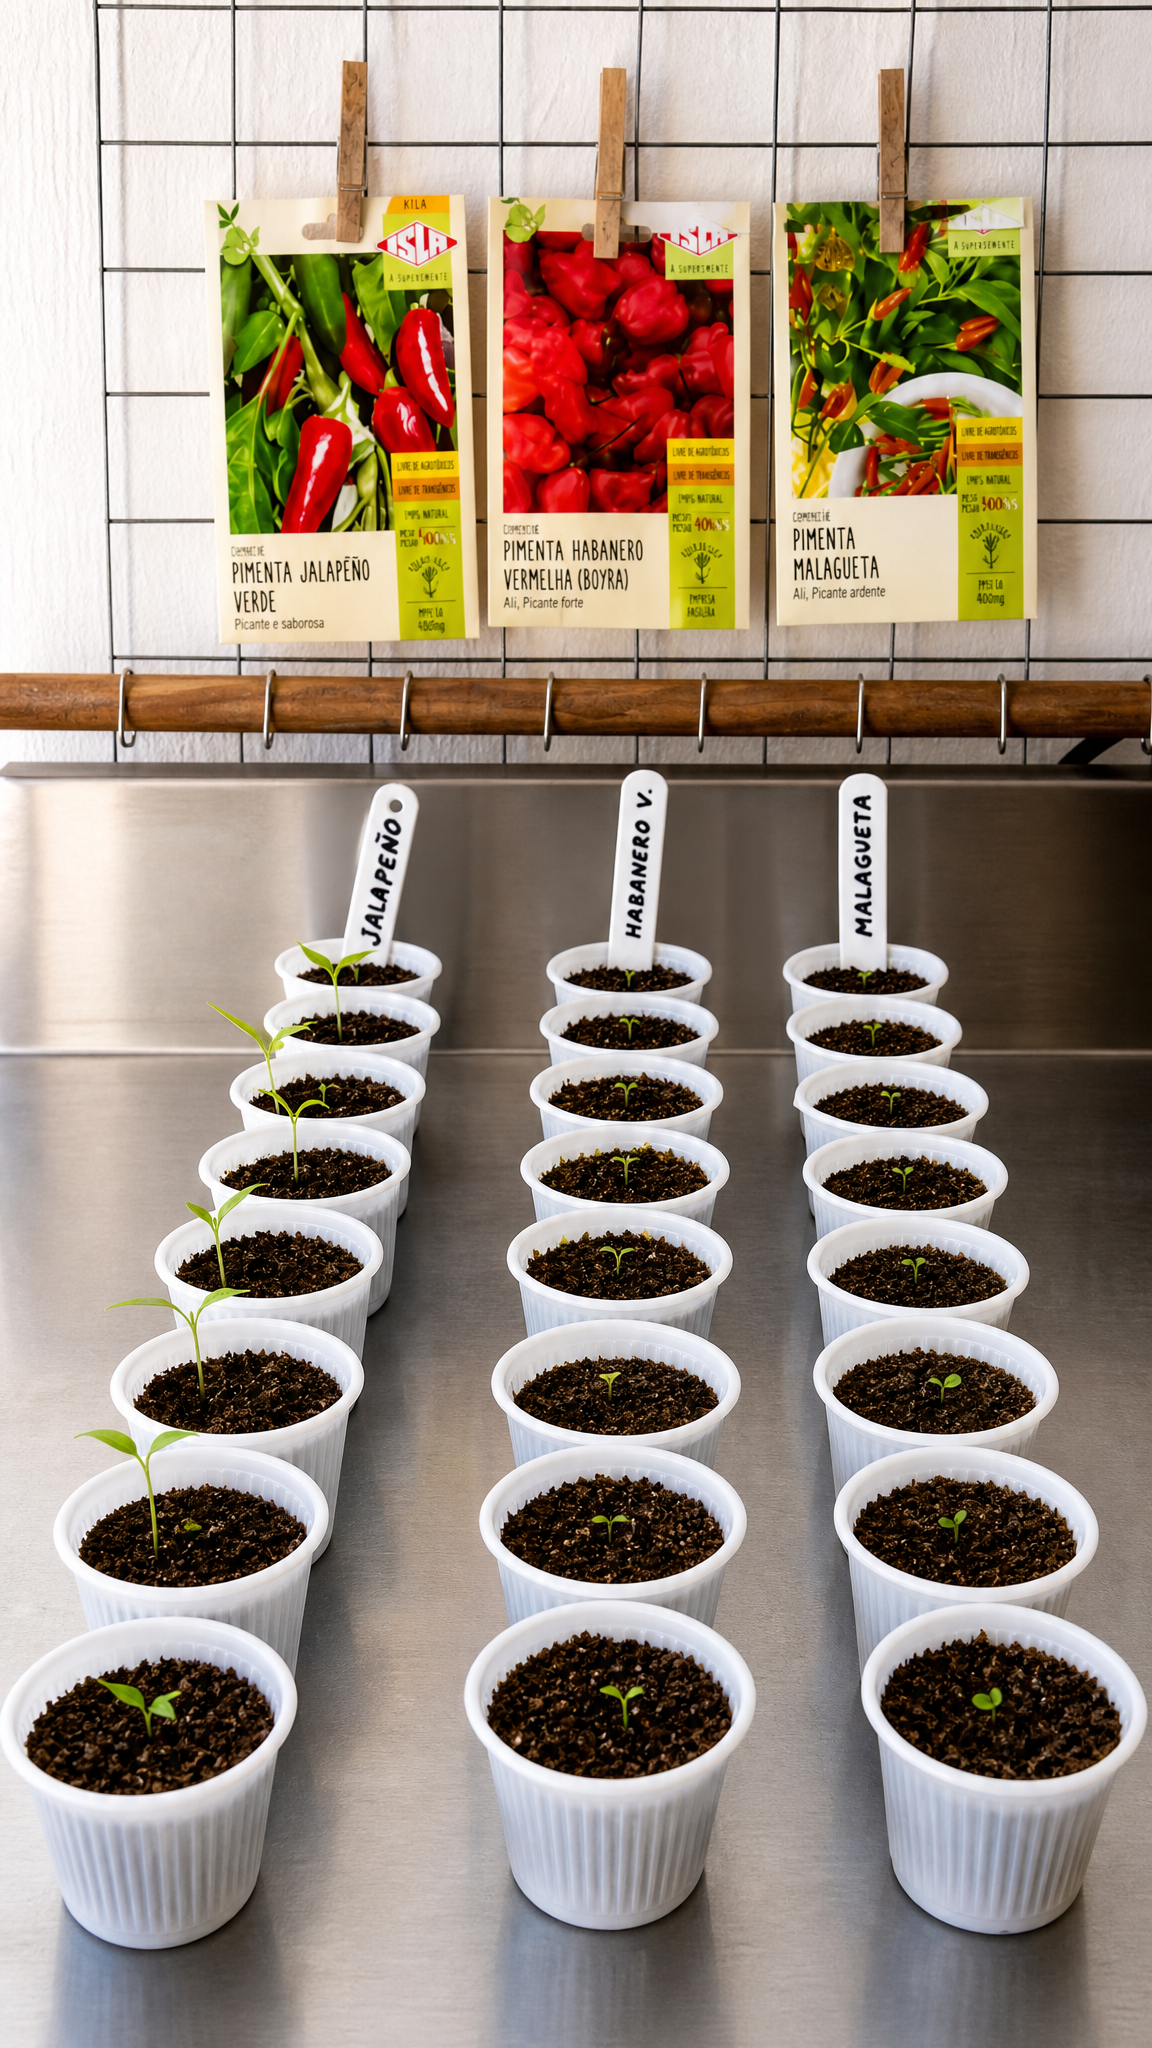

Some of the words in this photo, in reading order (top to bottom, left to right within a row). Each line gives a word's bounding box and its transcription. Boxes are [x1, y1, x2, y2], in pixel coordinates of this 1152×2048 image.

[403, 199, 427, 210] KILA
[387, 222, 448, 265] ISLA
[503, 539, 565, 562] PIMENTA
[572, 539, 644, 562] HABANERO
[793, 526, 856, 551] PIMENTA
[232, 560, 293, 584] PIMENTA
[503, 568, 573, 591] VERMELHA
[577, 568, 629, 592] (BOYRA)
[793, 555, 880, 581] MALAGUETA
[233, 589, 277, 613] VERDE
[523, 597, 559, 609] Picante
[561, 596, 584, 609] forte
[812, 586, 848, 600] Picante
[850, 585, 886, 599] ardente
[234, 618, 271, 630] Picante
[273, 621, 279, 630] e
[281, 617, 325, 630] saborosa
[636, 788, 653, 808] V.
[852, 794, 873, 937] MALAGUETA
[360, 818, 402, 947] JALAPEÑO
[625, 819, 651, 939] HABANERO
